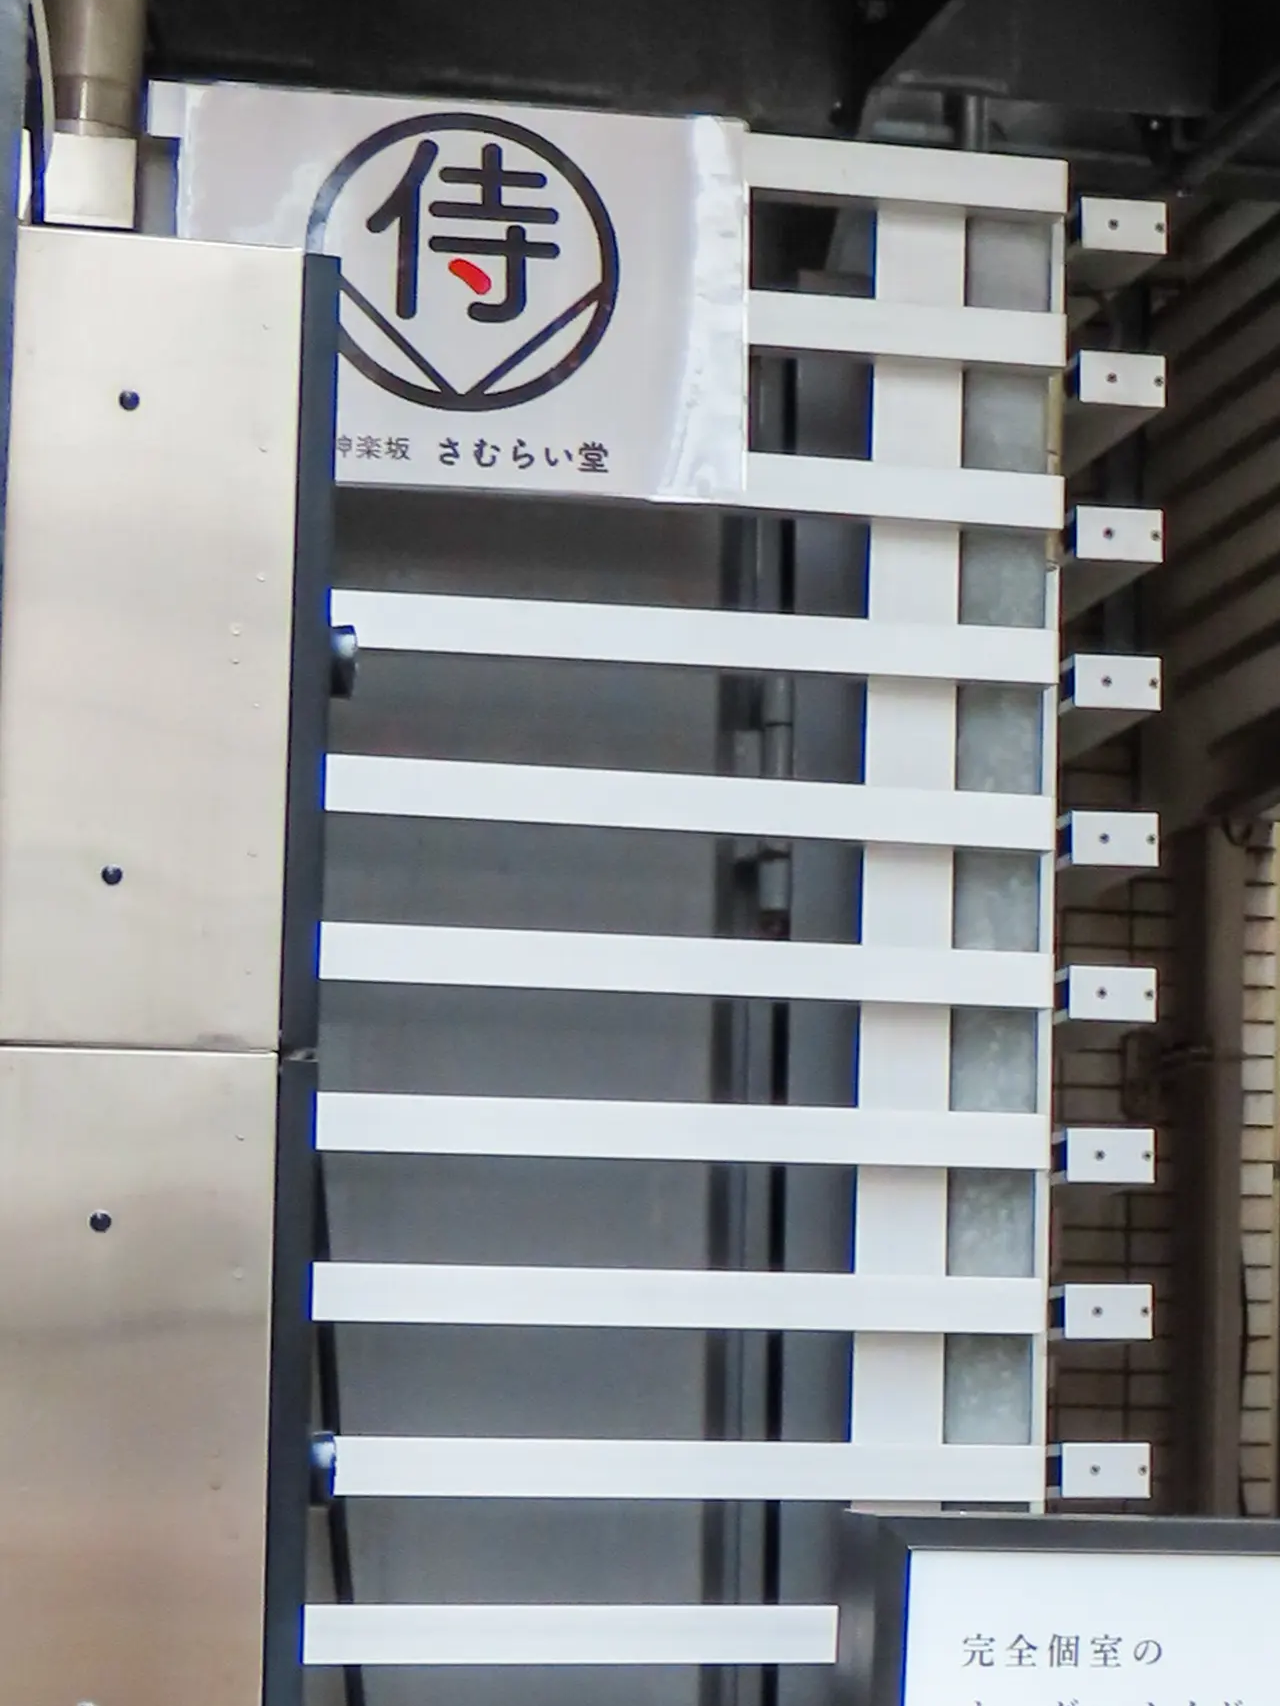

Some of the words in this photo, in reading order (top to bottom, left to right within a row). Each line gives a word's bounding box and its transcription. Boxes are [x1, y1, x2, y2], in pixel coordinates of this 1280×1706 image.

[366, 140, 559, 322] 侍
[439, 437, 609, 473] さむらい堂
[961, 1632, 1163, 1670] 完全個室の
